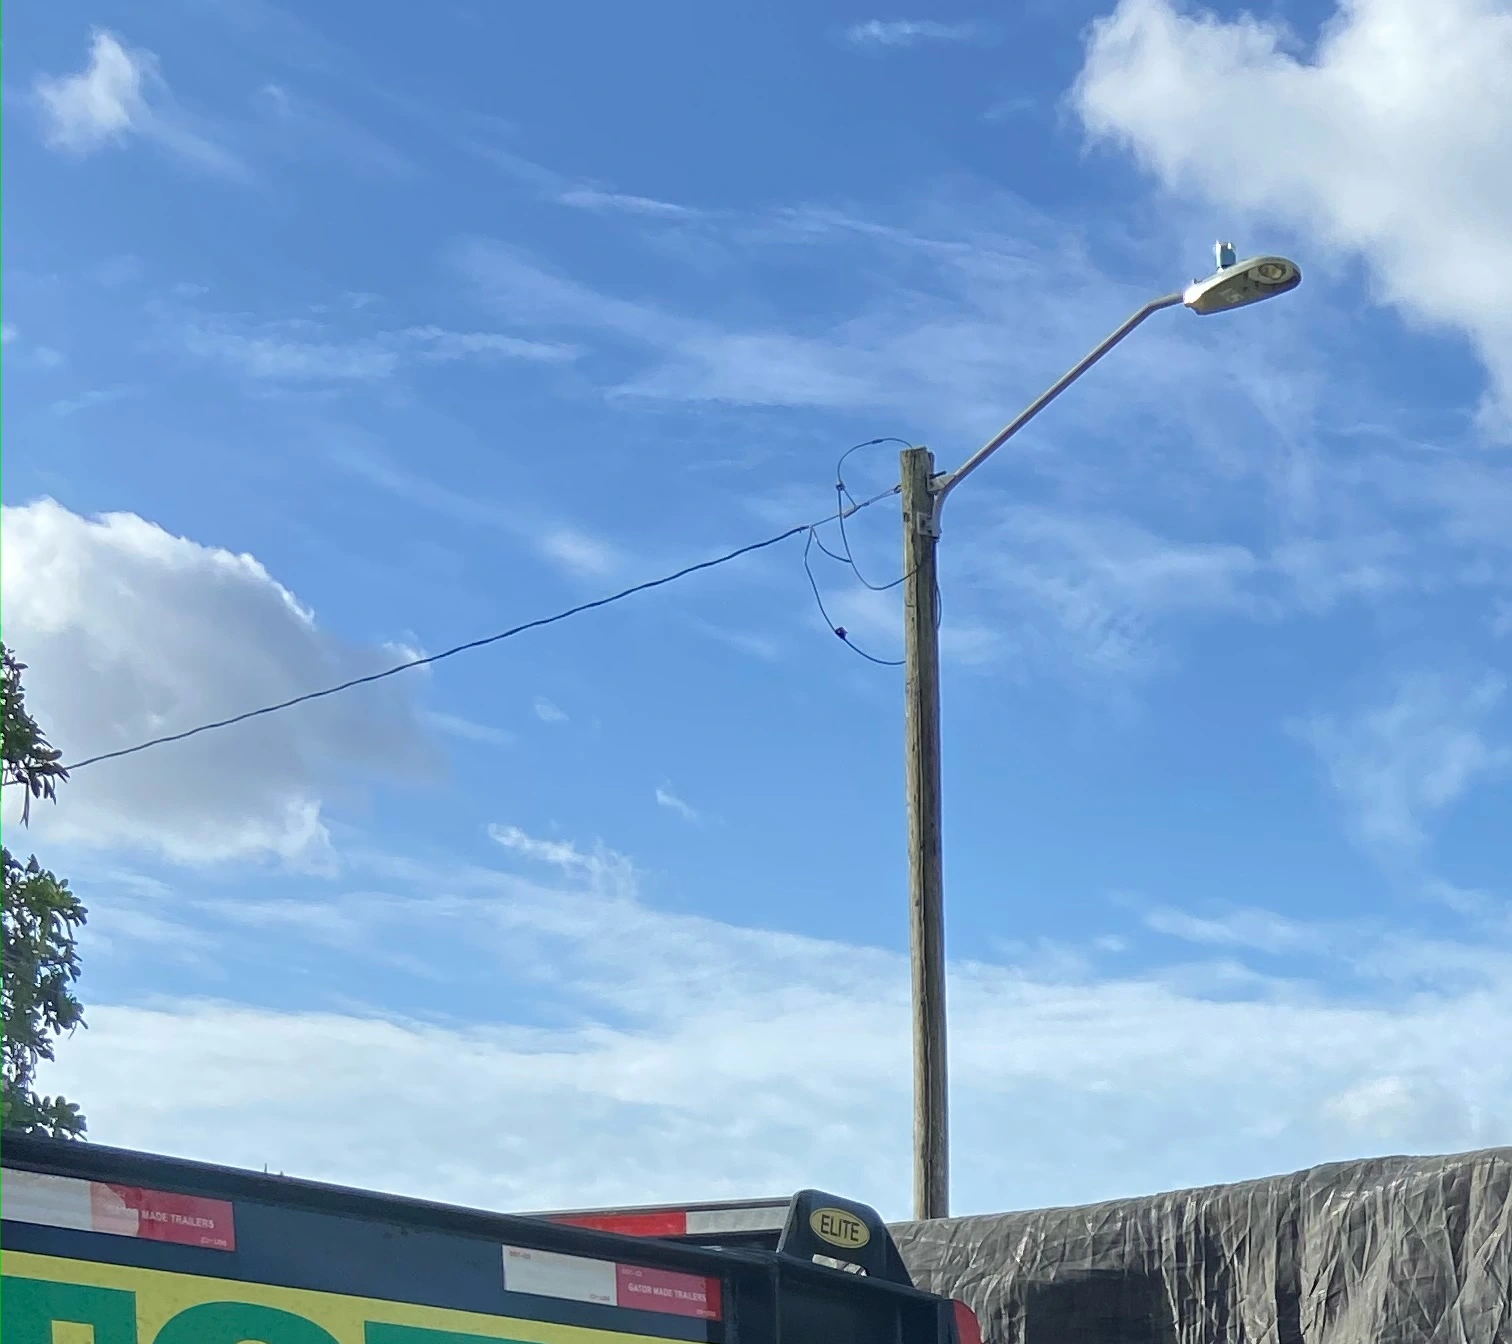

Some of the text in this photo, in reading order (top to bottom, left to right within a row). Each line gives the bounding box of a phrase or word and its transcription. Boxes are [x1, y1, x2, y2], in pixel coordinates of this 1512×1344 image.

[141, 1209, 168, 1223] MADE
[170, 1213, 215, 1230] TRAILERS
[820, 1213, 860, 1242] ELITE
